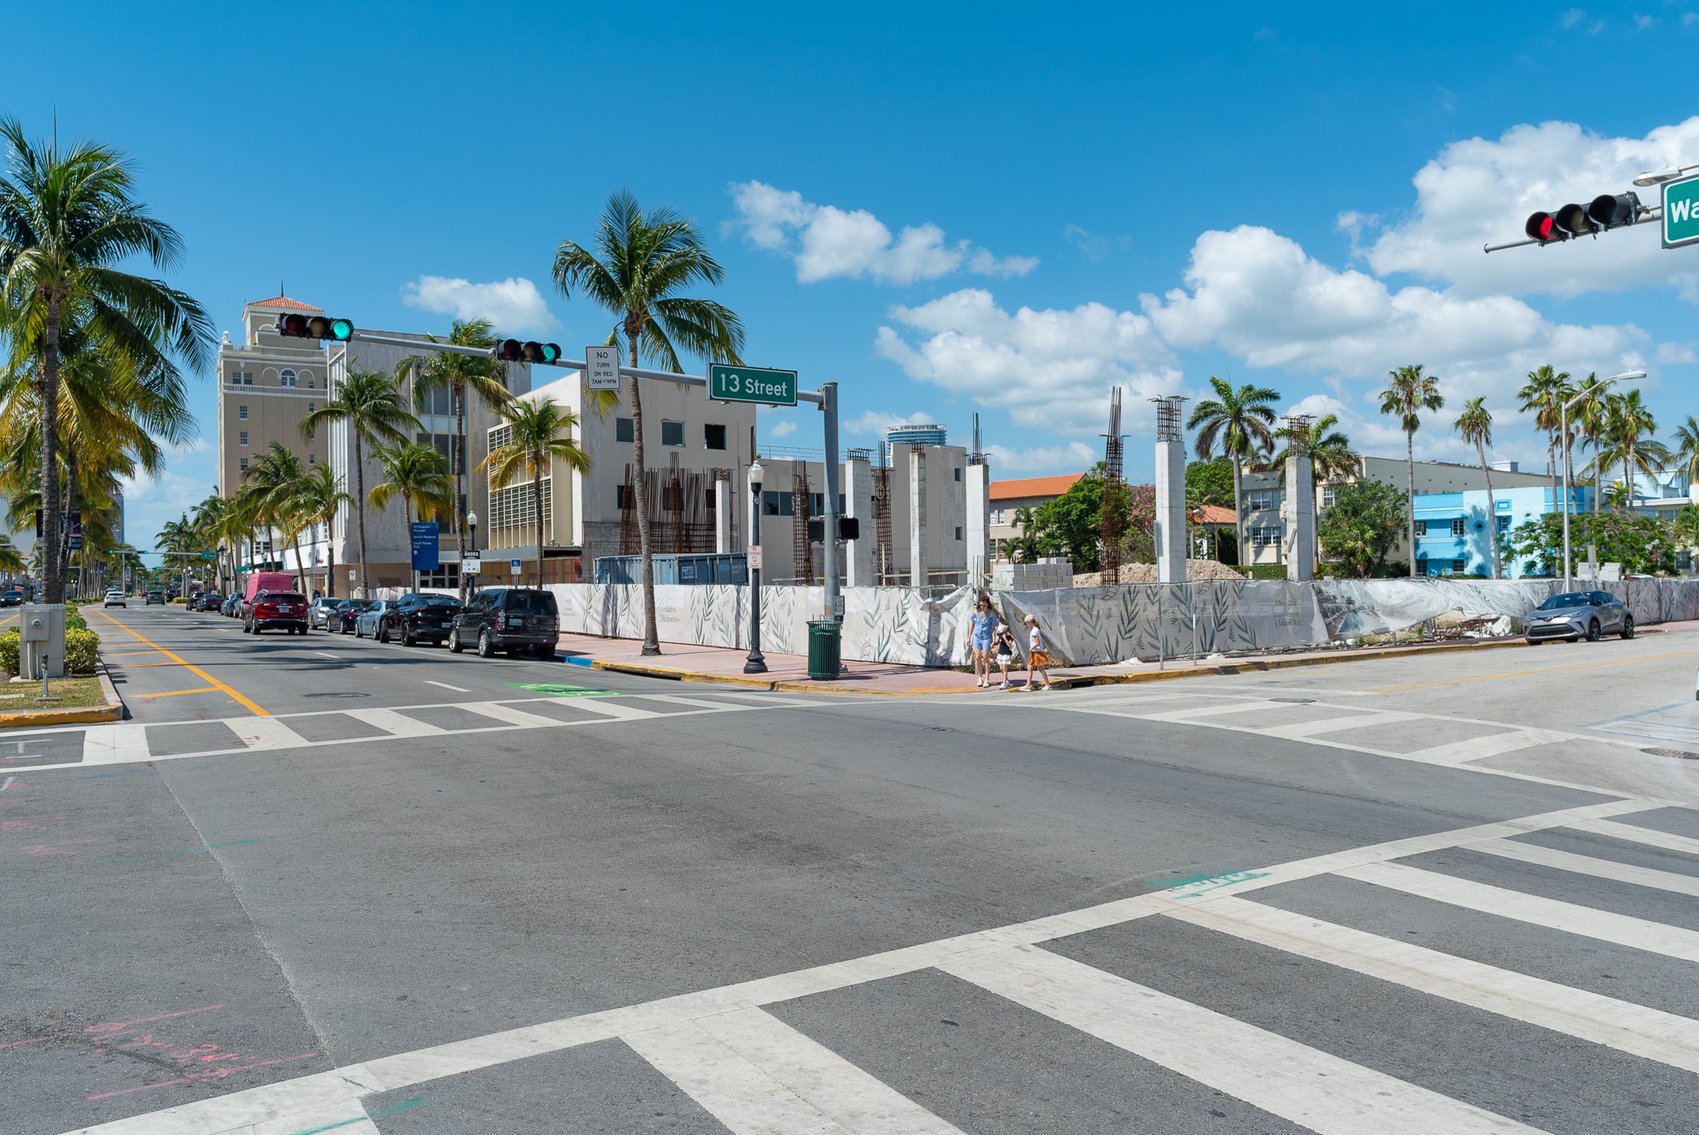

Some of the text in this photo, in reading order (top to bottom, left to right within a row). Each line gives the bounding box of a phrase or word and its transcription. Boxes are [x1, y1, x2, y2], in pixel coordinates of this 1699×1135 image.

[596, 351, 609, 359] NO
[720, 373, 788, 397] 13 Street
